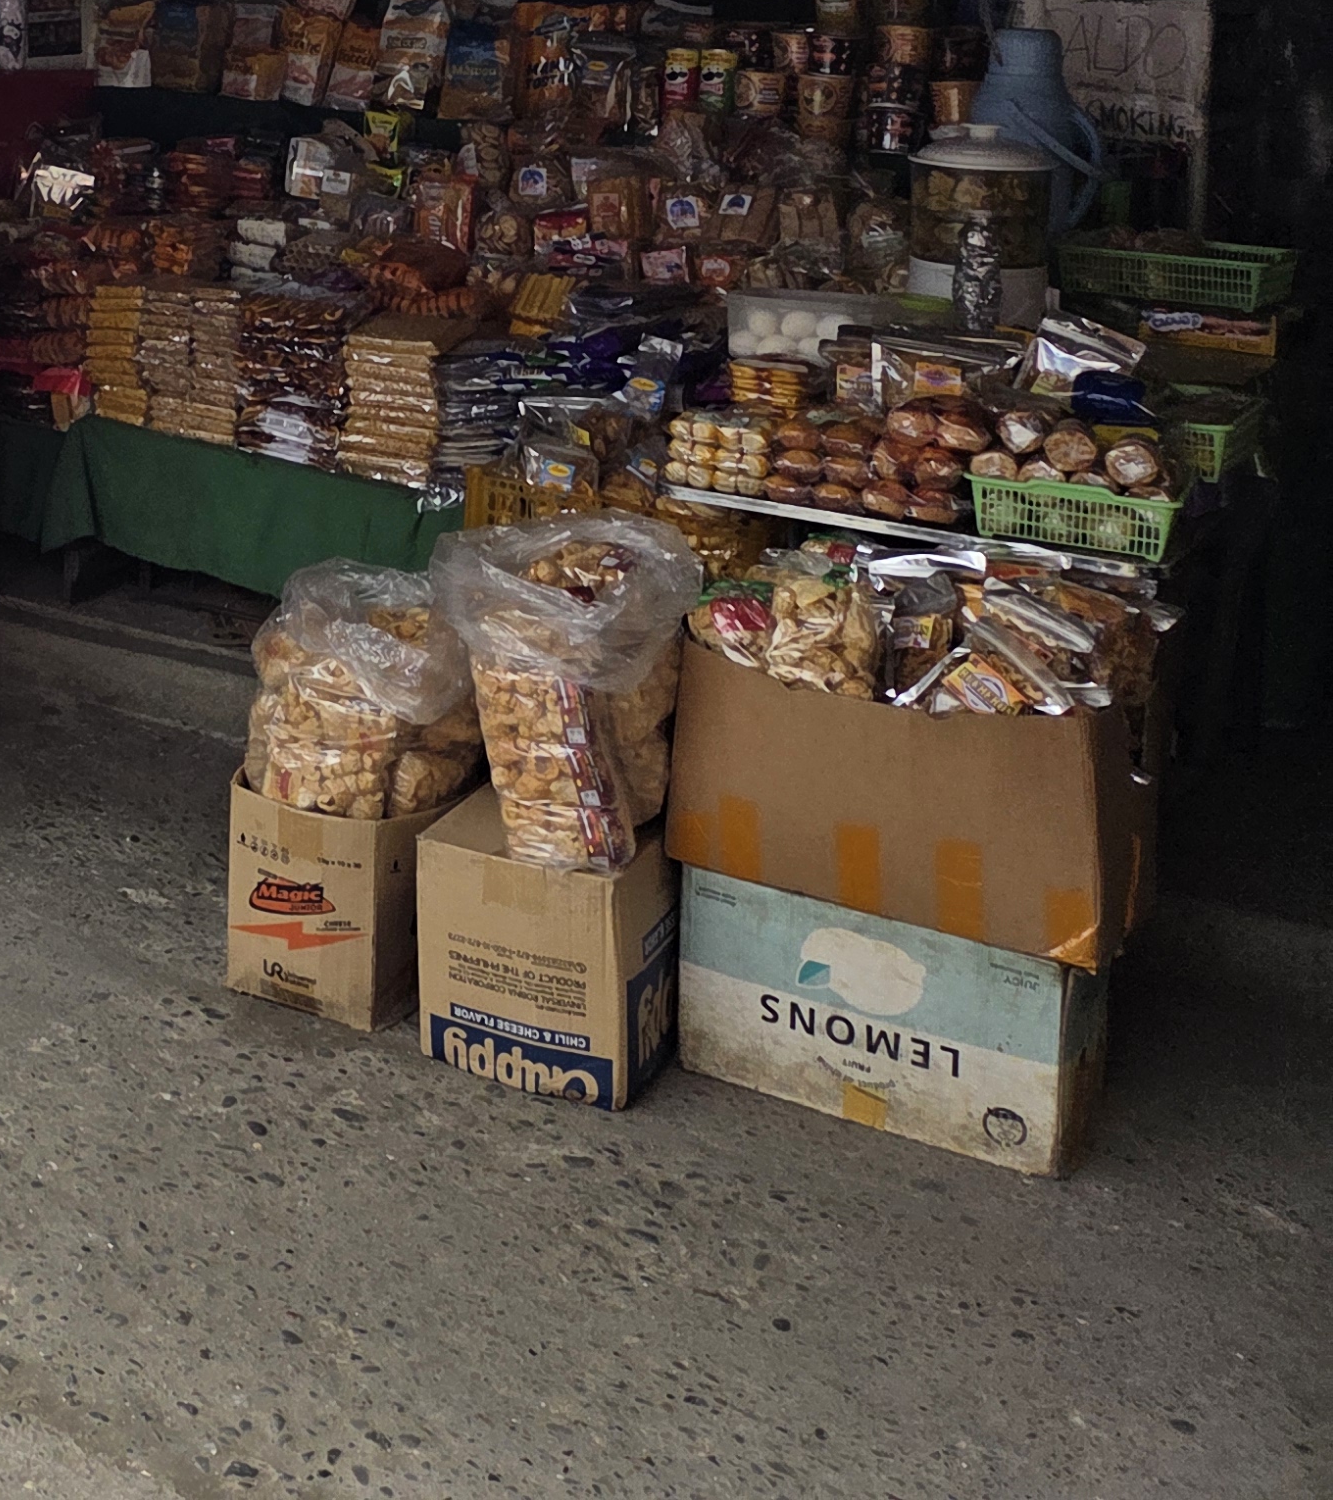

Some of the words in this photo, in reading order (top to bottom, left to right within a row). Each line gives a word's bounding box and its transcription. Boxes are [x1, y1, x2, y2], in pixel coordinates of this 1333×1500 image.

[258, 882, 321, 901] Magic
[289, 903, 323, 913] JUNIOR
[1003, 974, 1041, 991] JUICY
[452, 1004, 495, 1028] FLAVOR
[495, 1020, 540, 1041] CHEESE
[543, 1030, 552, 1043] &
[760, 993, 960, 1078] LEMONS
[555, 1034, 587, 1049] CHILI
